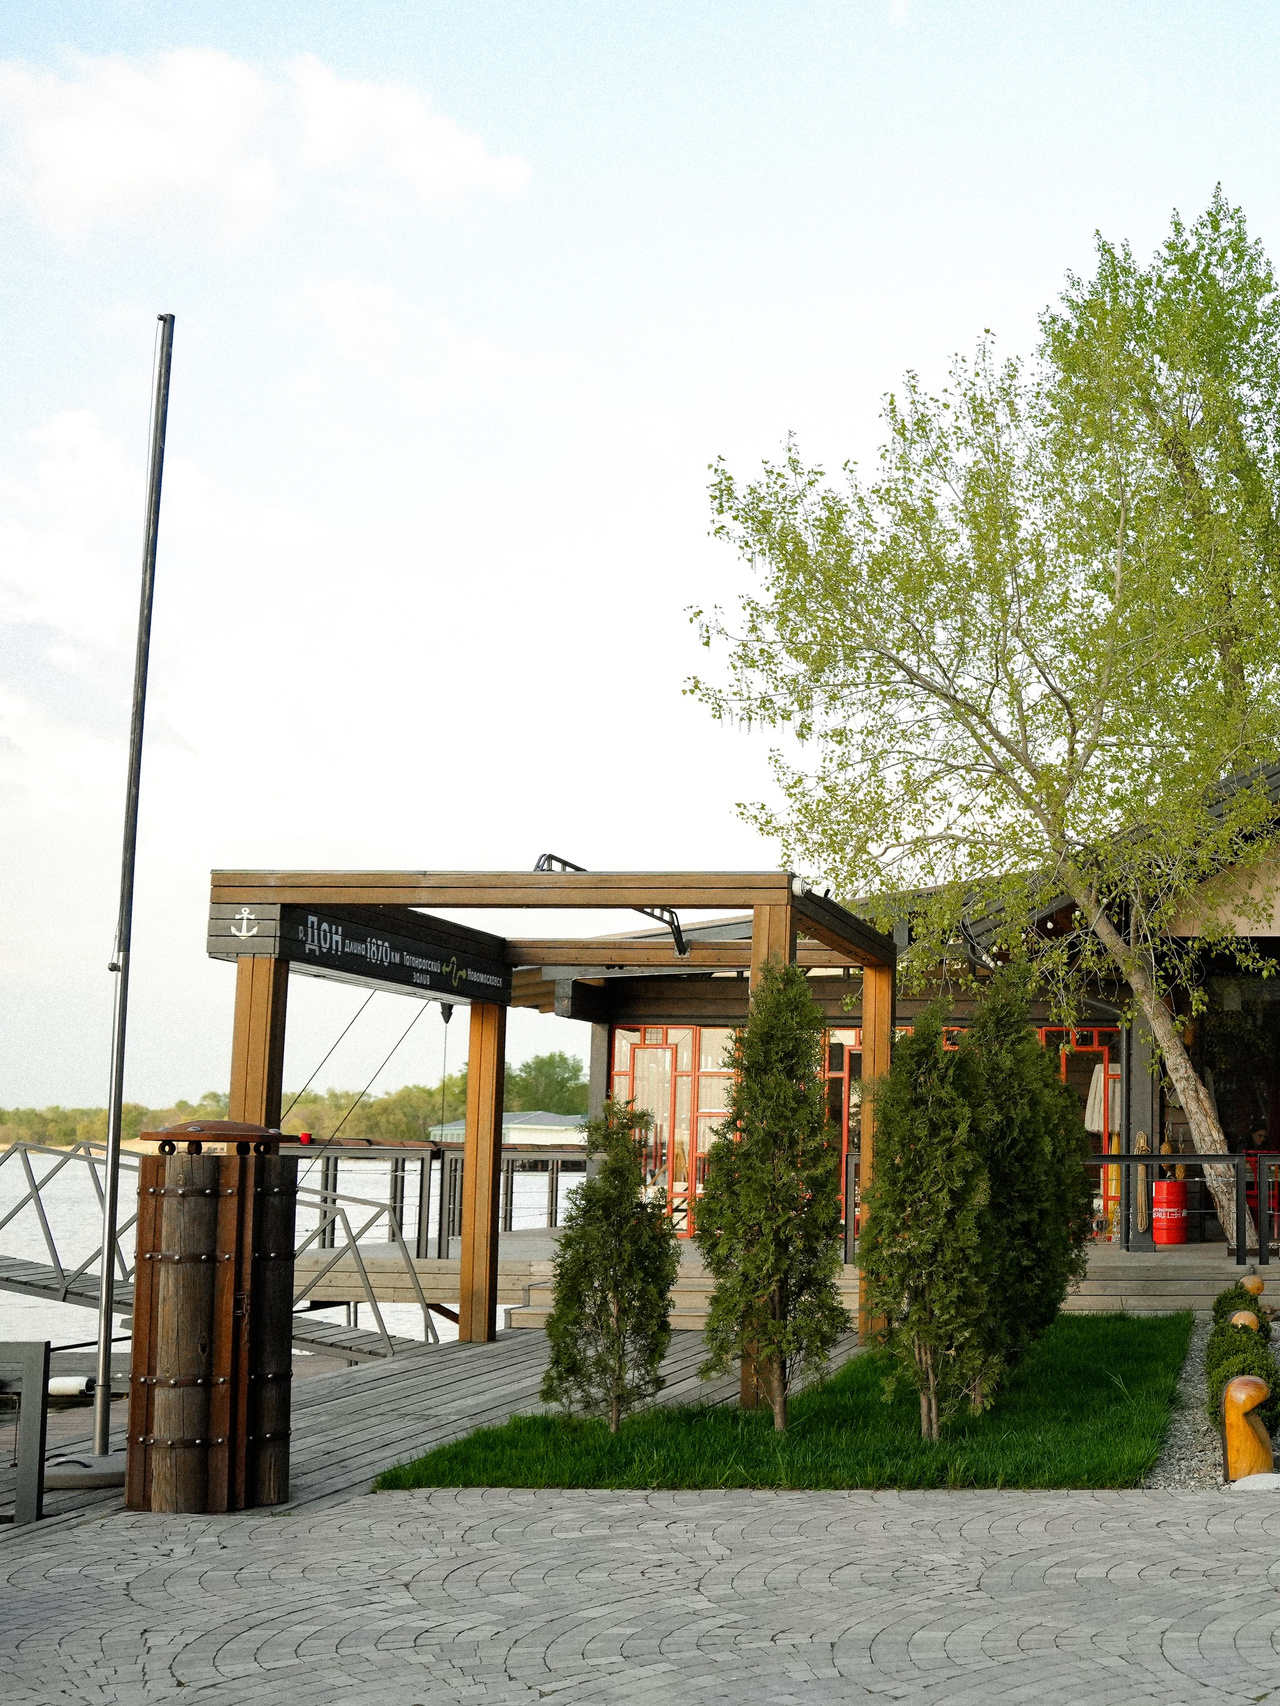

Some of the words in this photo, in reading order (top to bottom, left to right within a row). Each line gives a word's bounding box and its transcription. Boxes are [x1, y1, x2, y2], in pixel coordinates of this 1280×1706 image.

[305, 914, 342, 956] ДОН
[344, 940, 366, 955] длина
[366, 937, 390, 966] 1870
[391, 951, 400, 963] км
[403, 951, 441, 973] Таганрогский
[467, 968, 503, 987] Новомосковск
